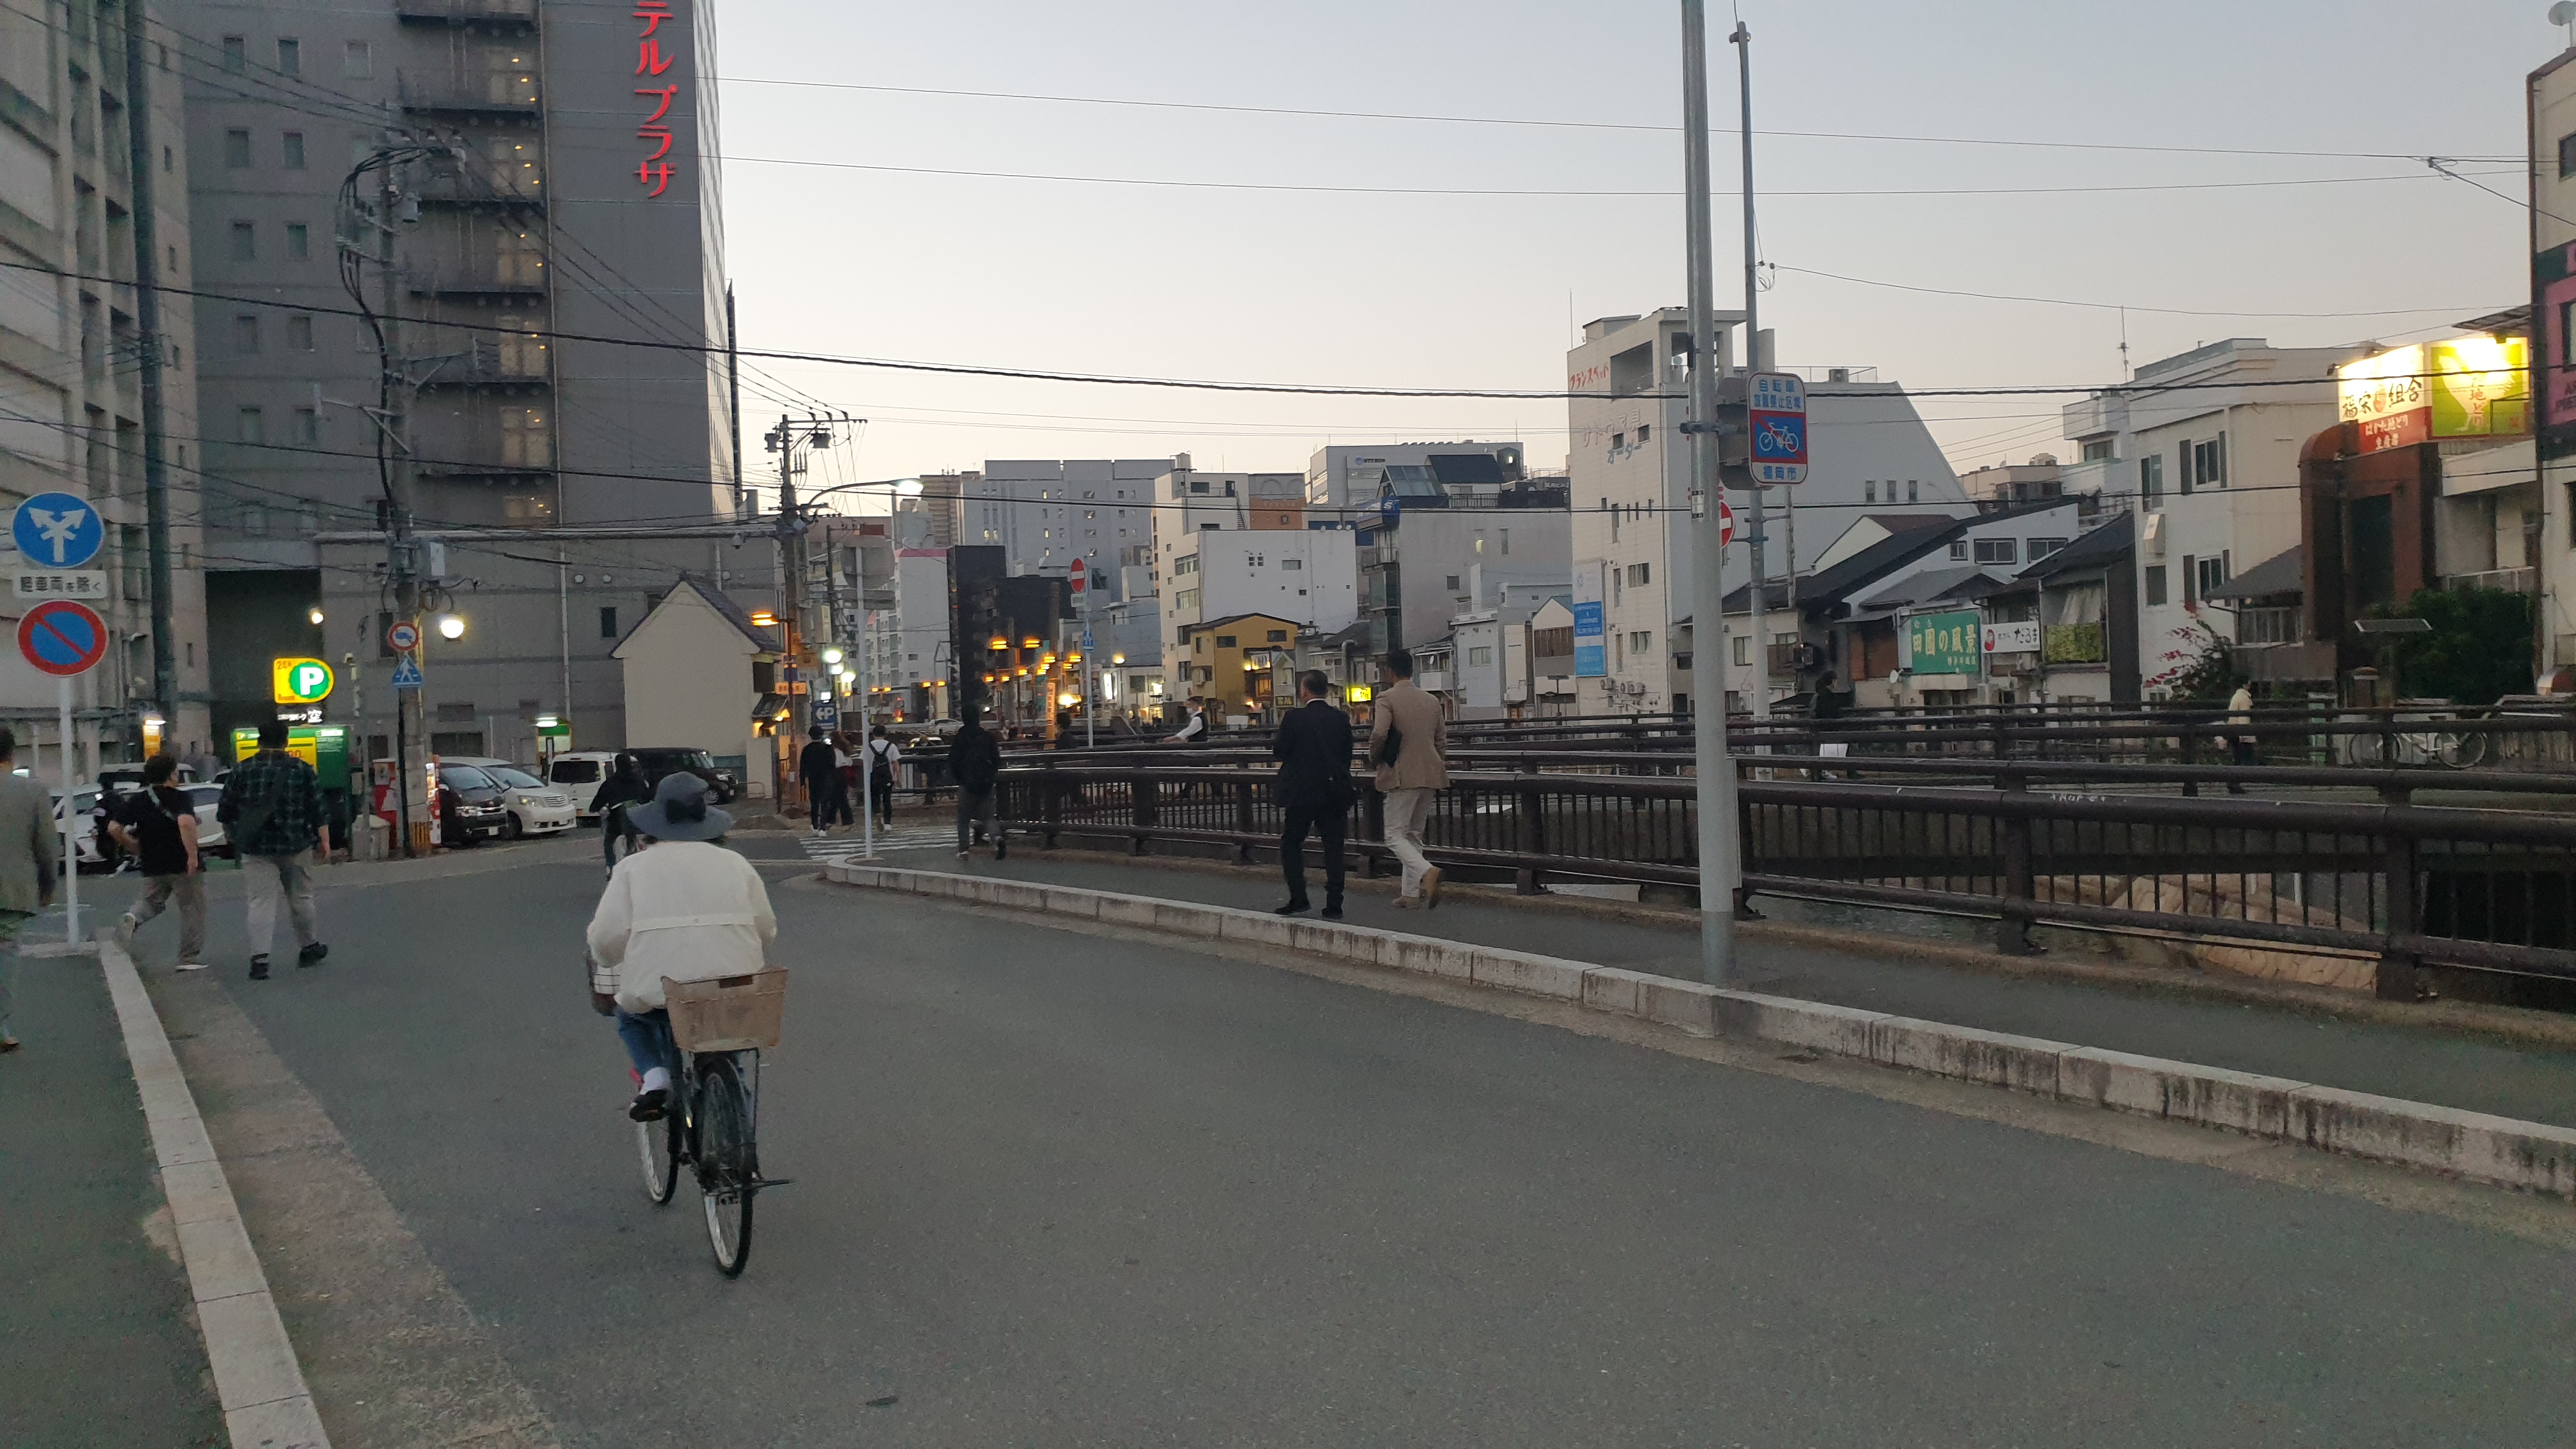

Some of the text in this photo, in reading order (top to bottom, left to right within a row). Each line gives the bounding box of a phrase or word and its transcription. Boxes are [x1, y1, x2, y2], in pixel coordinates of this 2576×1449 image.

[1759, 379, 1795, 392] 自転車
[1754, 394, 1802, 409] 放置禁止区域
[1763, 466, 1797, 480] 福岡市
[20, 576, 101, 593] 軽車両を除く
[299, 667, 325, 696] P
[824, 707, 834, 720] P
